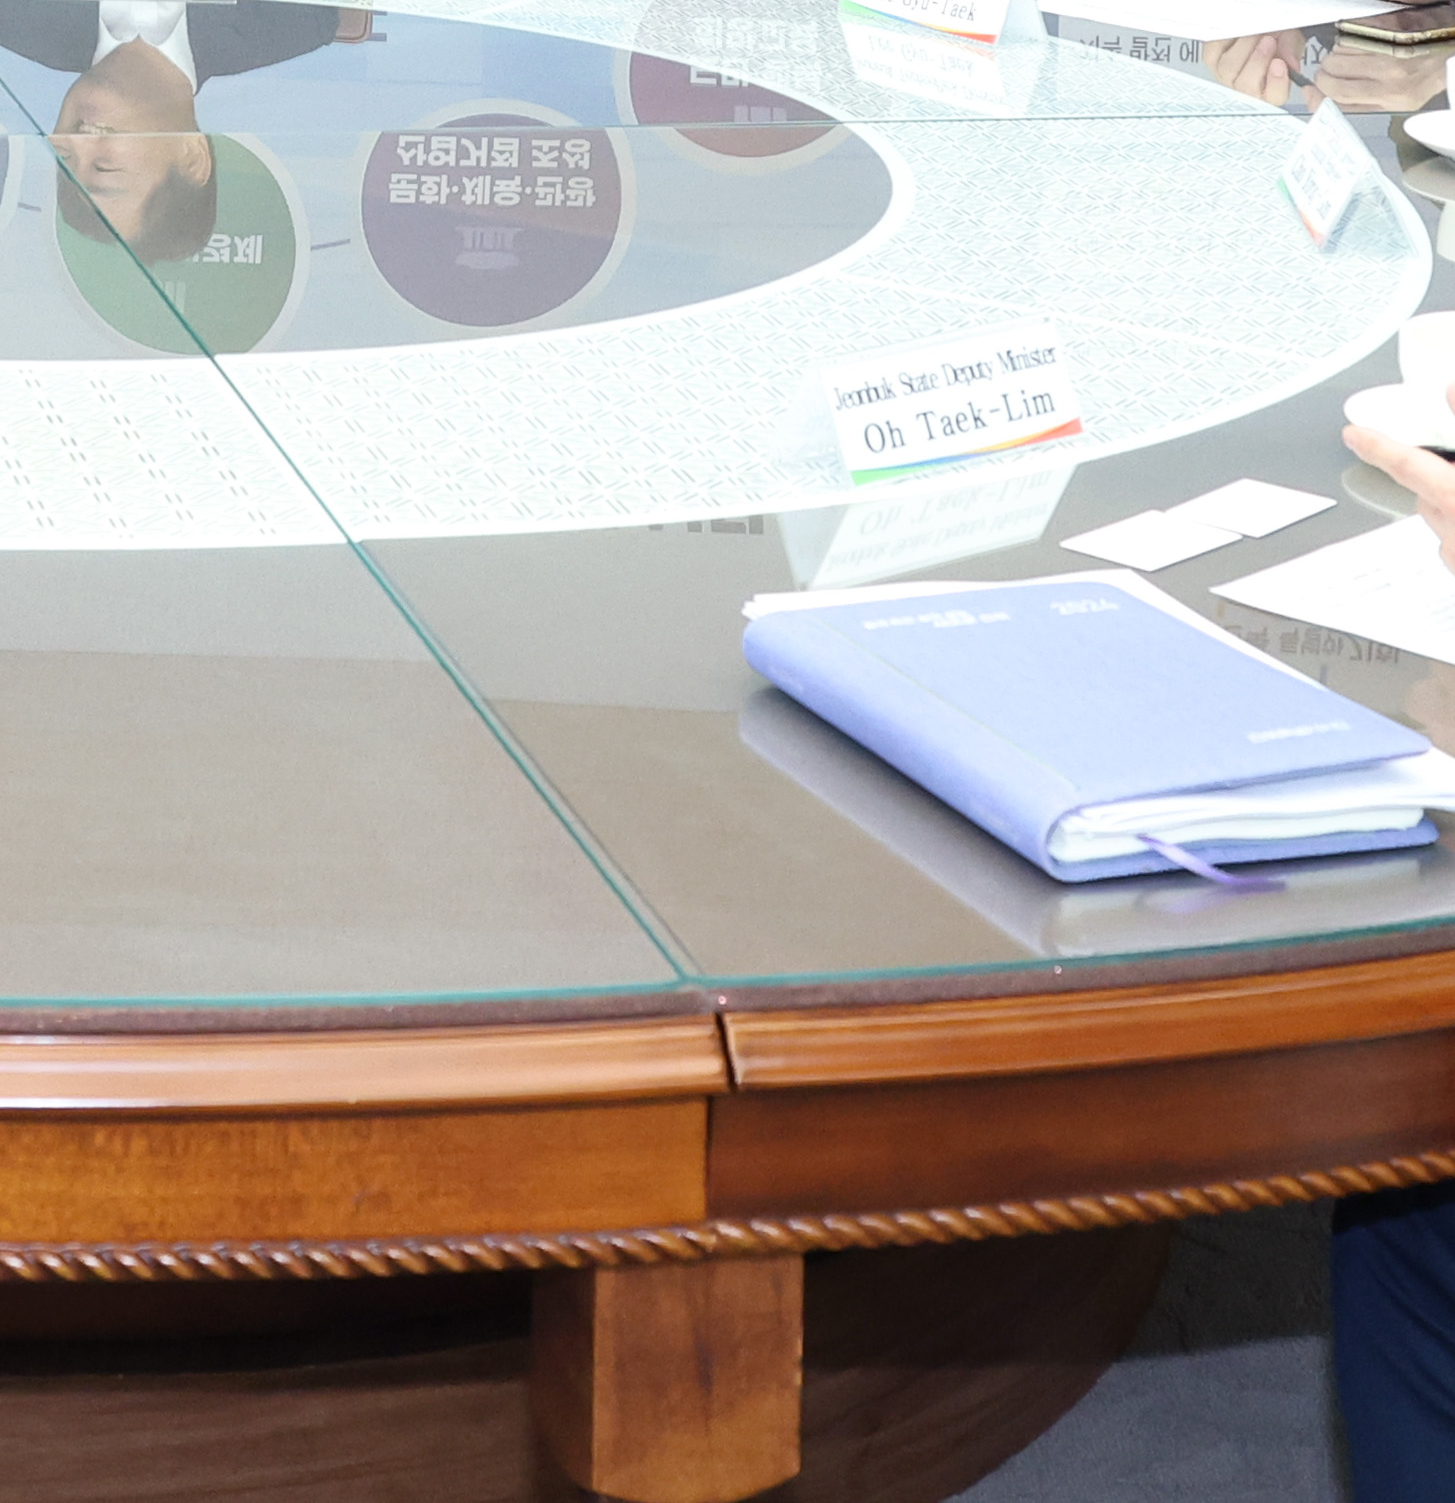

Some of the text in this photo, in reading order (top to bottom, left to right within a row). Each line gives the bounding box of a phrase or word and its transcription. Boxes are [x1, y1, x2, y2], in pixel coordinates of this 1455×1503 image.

[834, 346, 1057, 411] Jeonbuk State Deputy Minister
[863, 389, 1056, 454] Oh Taek-Lim
